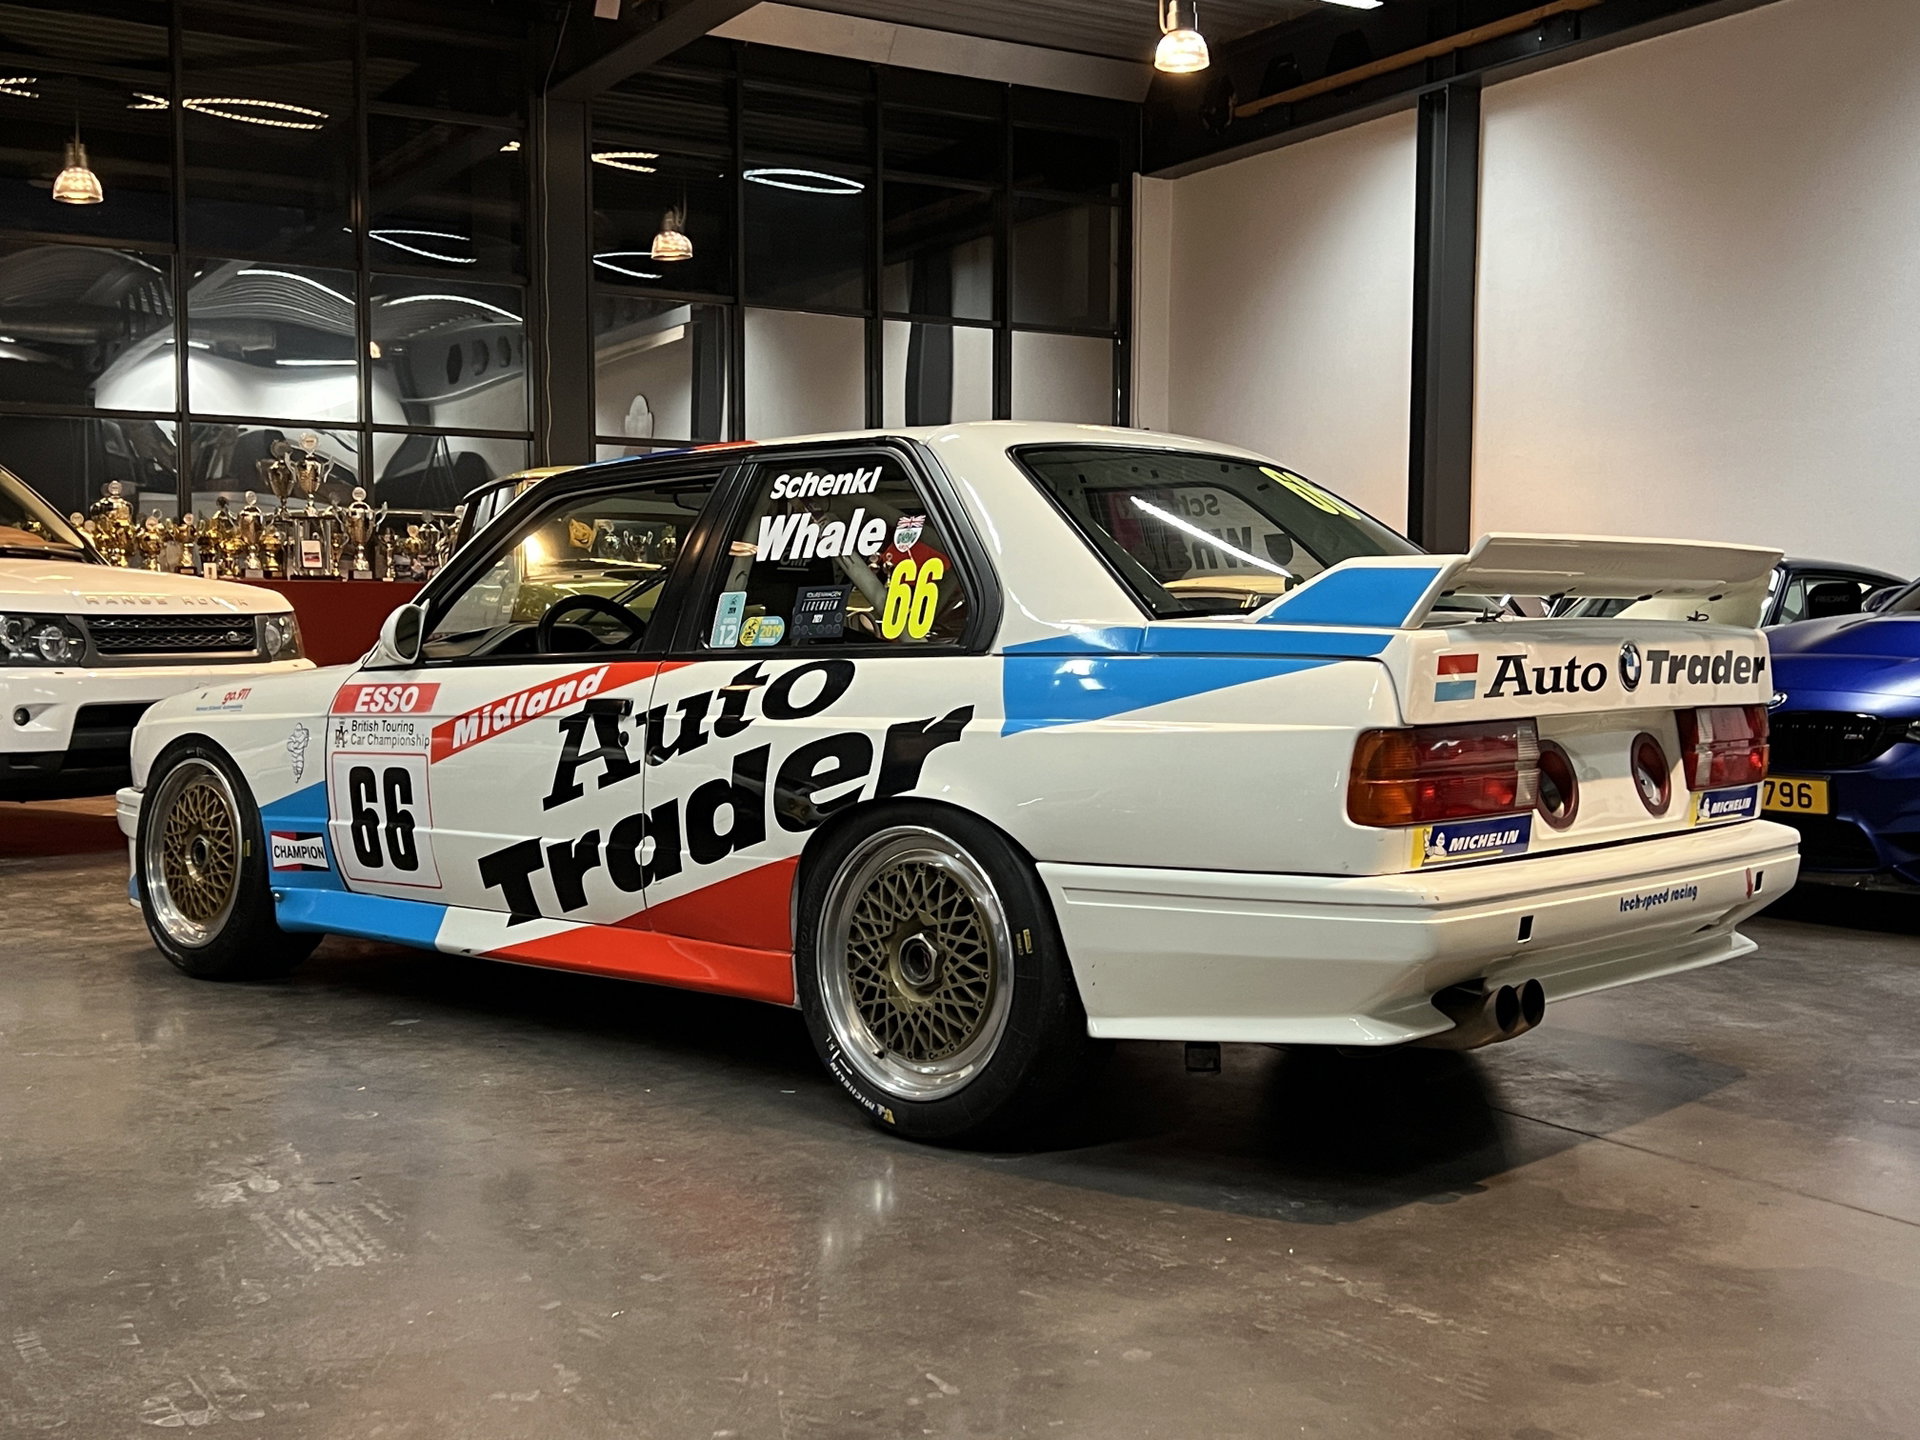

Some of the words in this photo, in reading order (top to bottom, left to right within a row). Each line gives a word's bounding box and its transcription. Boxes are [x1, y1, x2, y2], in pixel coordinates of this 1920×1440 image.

[770, 466, 882, 500] Schenkl
[755, 508, 887, 562] Whale
[85, 596, 168, 605] RANGE
[182, 597, 249, 606] ROVR
[881, 557, 945, 641] 66
[719, 625, 737, 645] 12
[760, 625, 783, 638] 2019
[1483, 654, 1608, 699] Auto
[1646, 650, 1766, 685] Trader
[354, 685, 420, 713] ESSO
[452, 665, 610, 749] Midland
[350, 734, 365, 746] Car
[367, 733, 430, 750] Championship
[351, 720, 379, 733] British
[381, 720, 414, 736] Touring
[543, 659, 856, 812] Auto
[349, 766, 419, 872] 66
[477, 705, 975, 928] Trader
[1710, 797, 1752, 814] MICHELIN
[273, 843, 325, 860] CHAMPION
[1449, 829, 1520, 851] MICHELIN
[1670, 884, 1698, 902] racing
